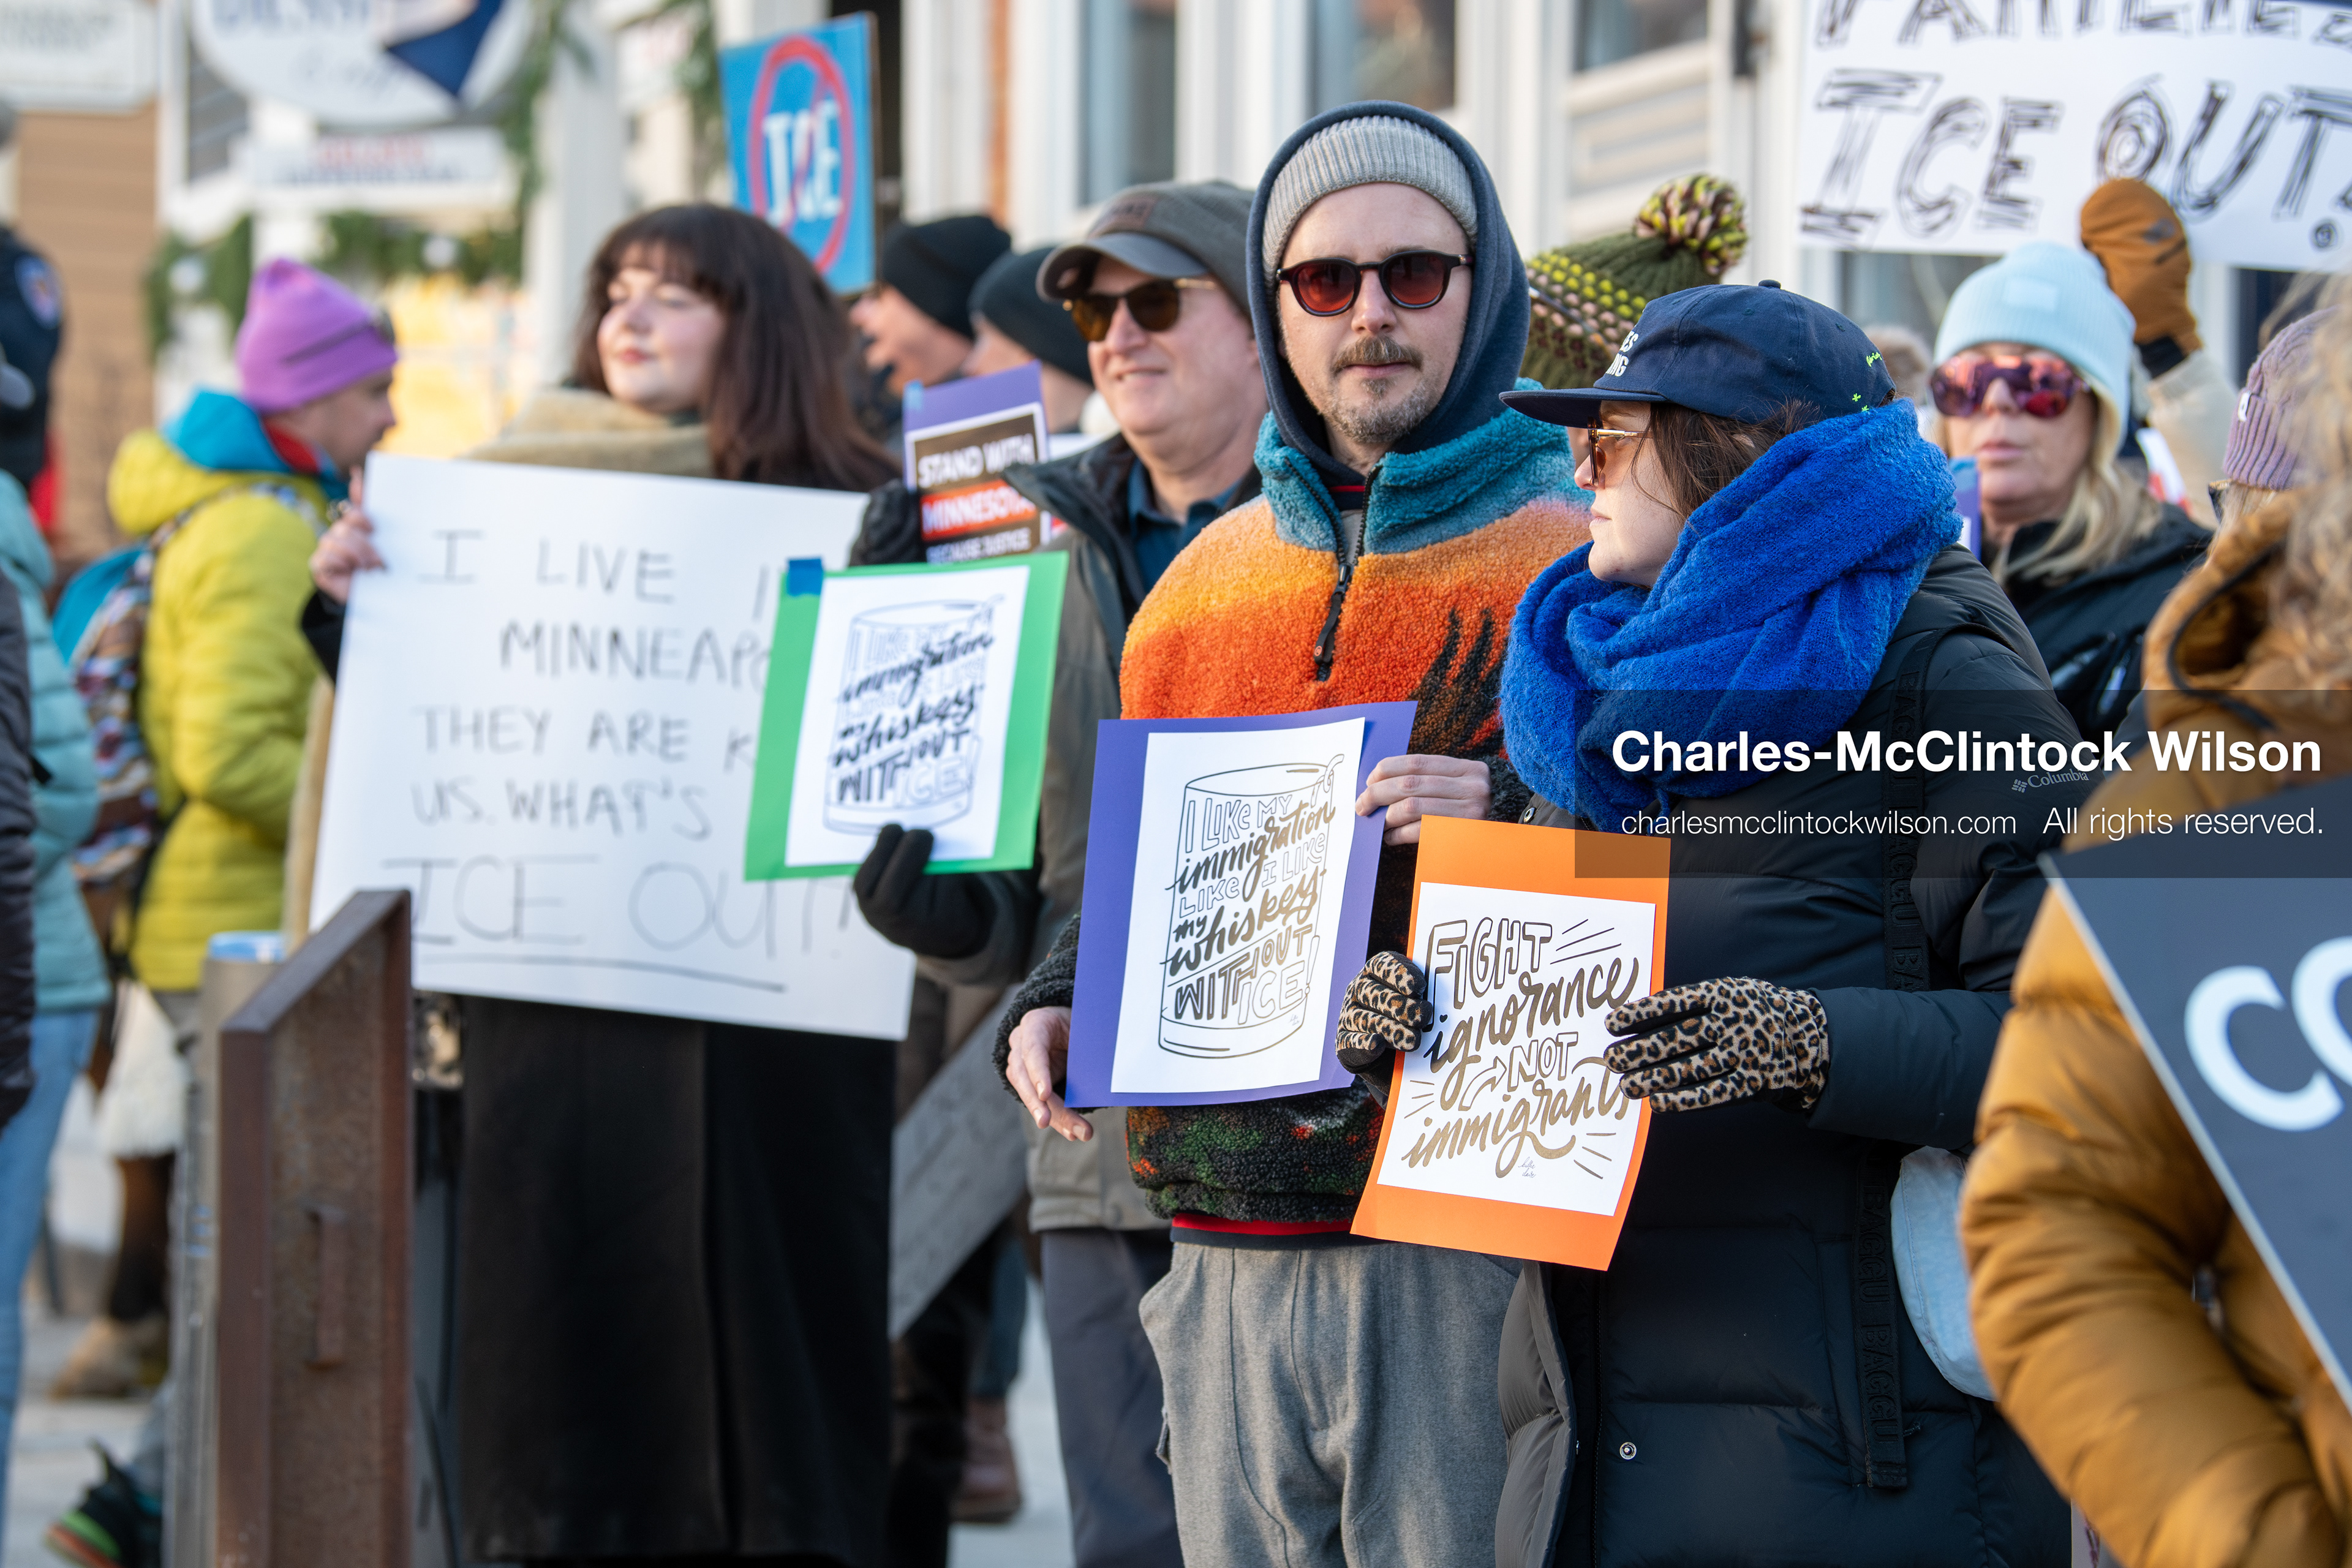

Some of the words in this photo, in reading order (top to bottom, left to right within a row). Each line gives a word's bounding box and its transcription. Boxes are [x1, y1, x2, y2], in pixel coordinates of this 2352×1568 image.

[762, 102, 843, 222] ICE
[1799, 67, 2065, 246] ICE
[918, 445, 984, 488] STAND
[982, 432, 1036, 474] WITH
[417, 529, 484, 584] I
[537, 537, 676, 605] LIVE
[835, 631, 996, 709] immigration
[410, 704, 551, 756] THEY
[587, 708, 690, 763] ARE
[832, 682, 984, 767] whiskey
[837, 727, 971, 802] WITHOUT
[506, 776, 712, 841] WHAT'S
[2027, 768, 2089, 788] Columbia
[1165, 804, 1336, 902] immigration
[1185, 801, 1196, 854] I
[1201, 796, 1251, 851] LIKE
[1256, 794, 1294, 828] MY
[381, 853, 601, 946] ICE
[1179, 876, 1240, 918] LIKE
[1262, 860, 1276, 888] I
[1281, 832, 1325, 883] LIKE
[1160, 869, 1327, 978] whiskey
[1174, 909, 1207, 943] my
[1174, 923, 1313, 1020] WITHOUT
[1237, 934, 1321, 1025] ICE!
[1423, 917, 1553, 1032] FIGHT
[1423, 957, 1639, 1112] ignorance
[1507, 1031, 1579, 1093] NOT
[1861, 1323, 1899, 1443] BAGGU
